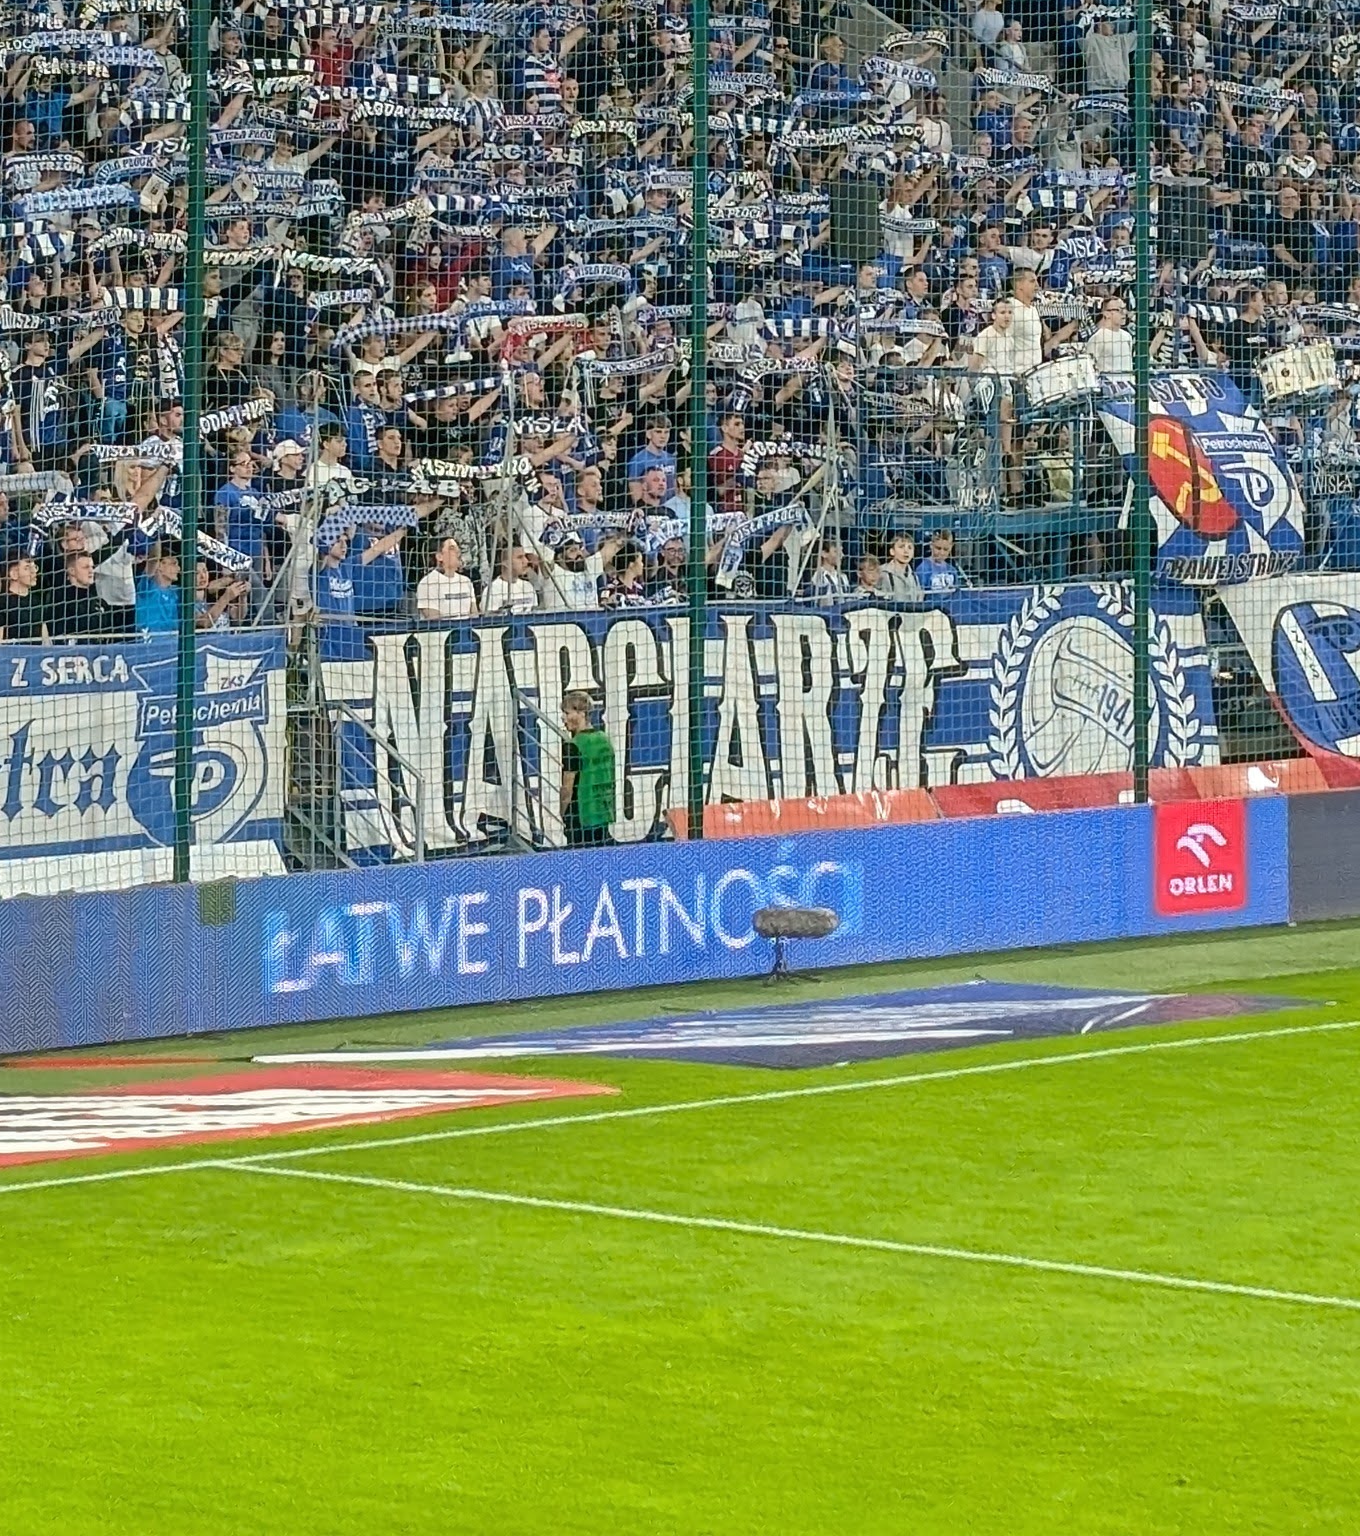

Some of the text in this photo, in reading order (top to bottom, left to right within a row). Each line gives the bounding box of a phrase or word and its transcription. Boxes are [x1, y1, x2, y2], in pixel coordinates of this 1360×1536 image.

[502, 204, 550, 219] WISŁA
[1056, 236, 1107, 259] WISŁA
[513, 416, 586, 434] WISŁA
[1201, 435, 1271, 453] Petrochemia
[11, 657, 29, 687] Z
[40, 654, 130, 686] SERCA
[1169, 873, 1232, 896] ORLEN
[263, 891, 490, 994] ŁATWE
